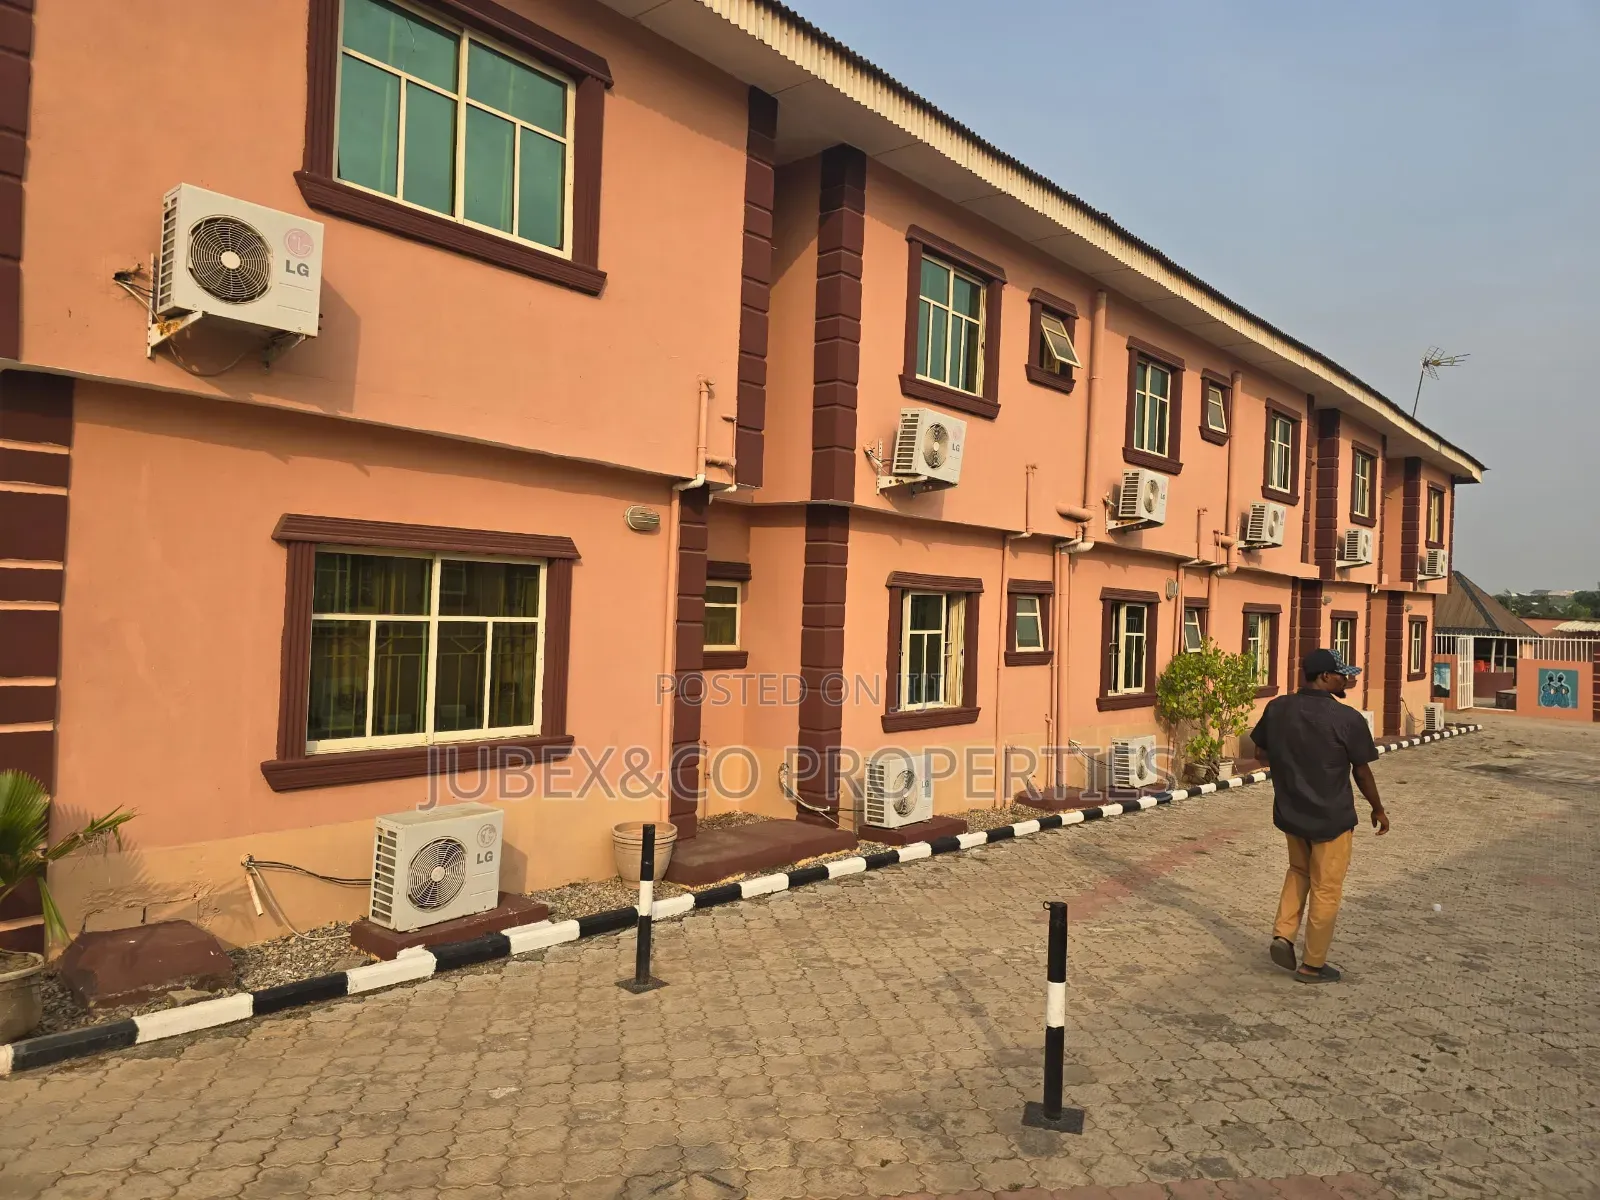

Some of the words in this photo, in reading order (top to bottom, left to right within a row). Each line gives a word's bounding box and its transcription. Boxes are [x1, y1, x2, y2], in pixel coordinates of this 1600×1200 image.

[285, 259, 310, 278] LG
[952, 443, 960, 452] LG
[922, 780, 930, 788] LG
[476, 850, 494, 865] LG
